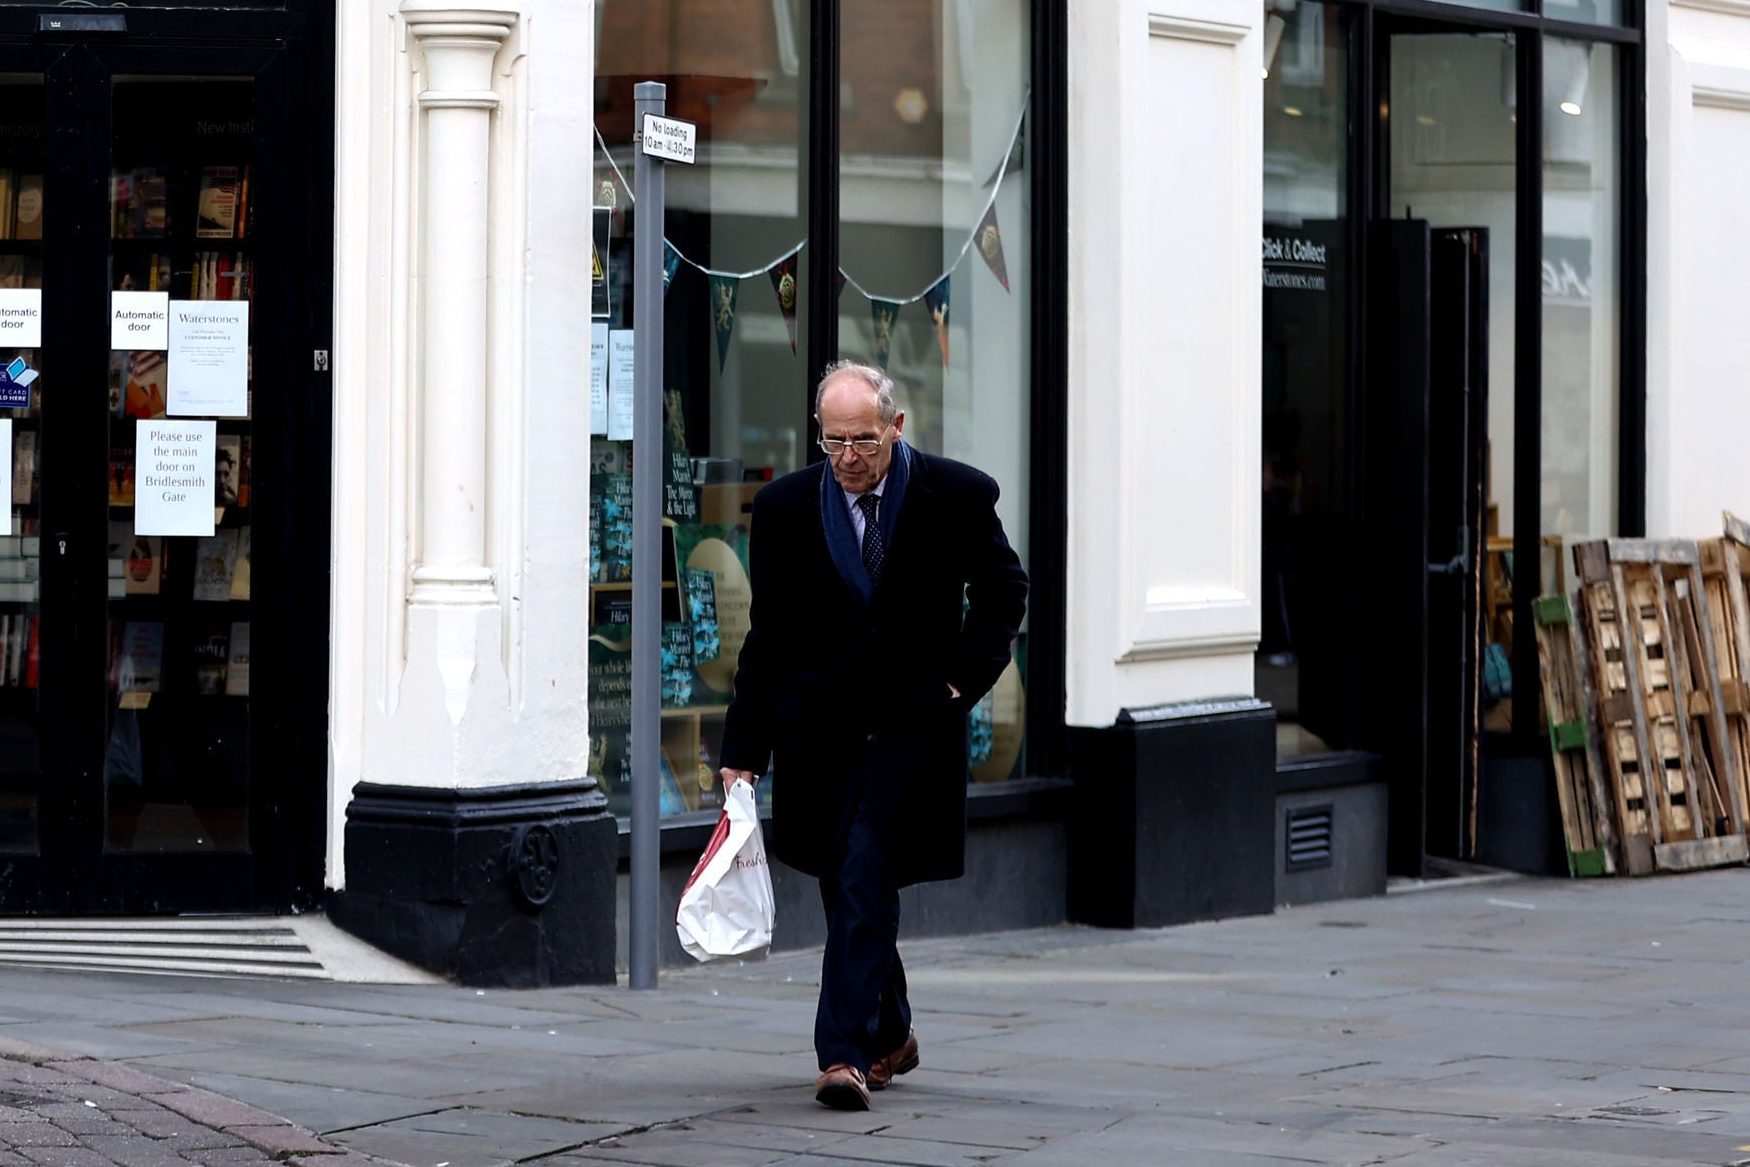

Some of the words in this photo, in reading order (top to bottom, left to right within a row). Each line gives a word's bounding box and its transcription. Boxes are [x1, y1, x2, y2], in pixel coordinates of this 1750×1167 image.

[652, 121, 662, 133] No
[664, 122, 687, 141] loading
[1293, 239, 1326, 262] Collect
[115, 310, 164, 320] Automatic
[178, 313, 239, 324] Waterstones
[1, 320, 24, 329] door
[128, 323, 151, 331] door
[150, 430, 182, 442] Please
[185, 433, 202, 442] use
[153, 446, 169, 457] the
[172, 446, 198, 457] main
[155, 461, 179, 472] door
[182, 463, 195, 472] on
[145, 476, 205, 487] Bridlesmith
[162, 491, 187, 502] Gate
